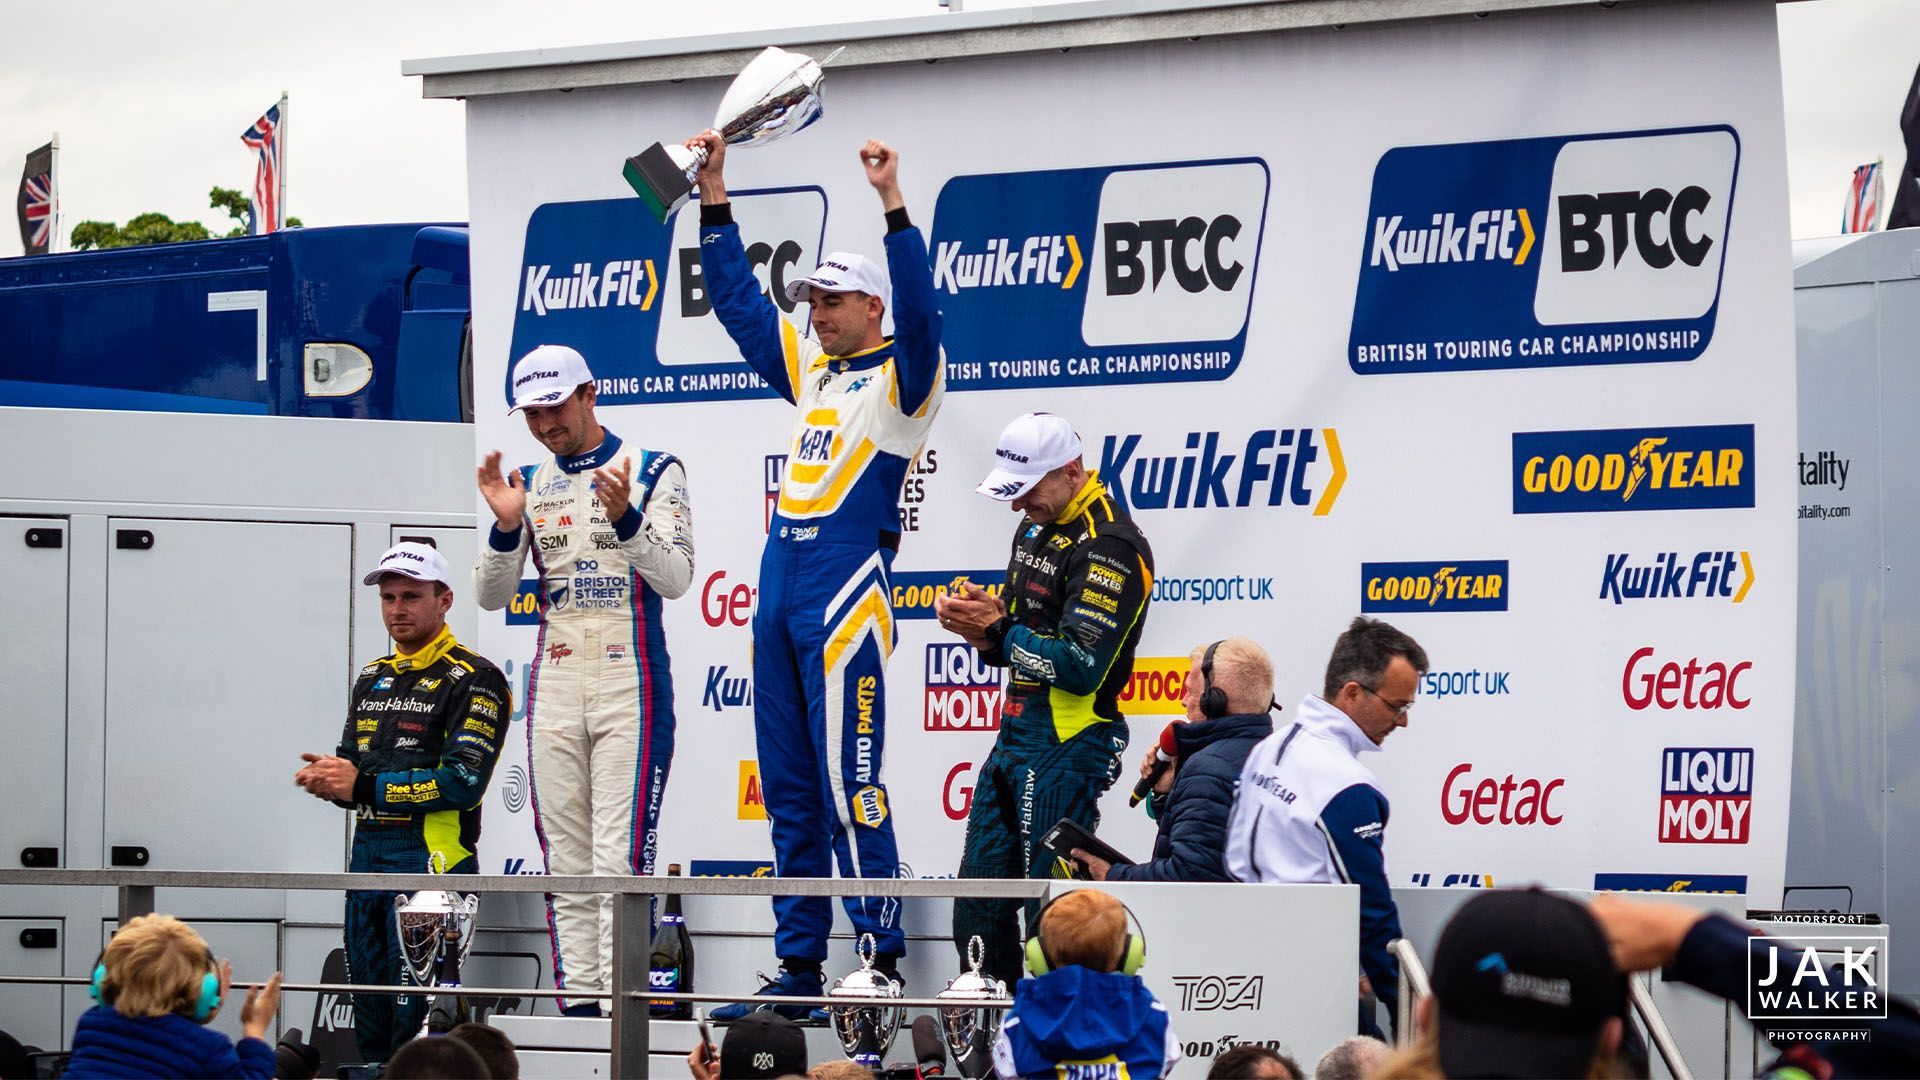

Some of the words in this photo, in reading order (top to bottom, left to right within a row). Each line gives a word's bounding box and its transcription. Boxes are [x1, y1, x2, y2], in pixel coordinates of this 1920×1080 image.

[1557, 185, 1713, 273] BTCC
[1104, 214, 1244, 297] BTCC
[679, 240, 803, 317] BCC
[1357, 343, 1427, 363] BRITISH
[1434, 339, 1512, 360] TOURING
[1519, 337, 1554, 356] CAR
[1561, 330, 1701, 353] CHAMPIONSHIP
[944, 362, 982, 380] TISH
[989, 359, 1061, 378] TOURING
[1067, 357, 1100, 375] CAR
[1105, 351, 1231, 373] CHAMPIONSHIP
[594, 377, 640, 395] URING
[644, 376, 675, 392] CAR
[1522, 446, 1744, 494] GOODYEAR
[1798, 451, 1850, 491] tality
[540, 534, 568, 550] S2M
[574, 577, 629, 588] BRISTOL
[1089, 573, 1121, 591] MAXED
[1091, 565, 1123, 584] POWER
[1151, 575, 1245, 605] otorsport
[1367, 574, 1503, 601] GOODYEAR
[575, 588, 624, 599] STREET
[575, 600, 621, 609] MOTORS
[1118, 670, 1190, 701] UTOC
[1417, 669, 1480, 699] rsport
[1622, 646, 1753, 710] Getac
[858, 676, 877, 734] PARTS
[927, 690, 1001, 728] MOLY
[856, 737, 872, 783] AUTO
[1664, 750, 1750, 793] LIQUI
[412, 779, 438, 794] Seal
[1021, 768, 1036, 834] Halshaw
[1441, 763, 1565, 825] Getac
[863, 789, 881, 823] NAPA
[1662, 798, 1751, 840] MOLY
[1171, 975, 1264, 1011] TOCA
